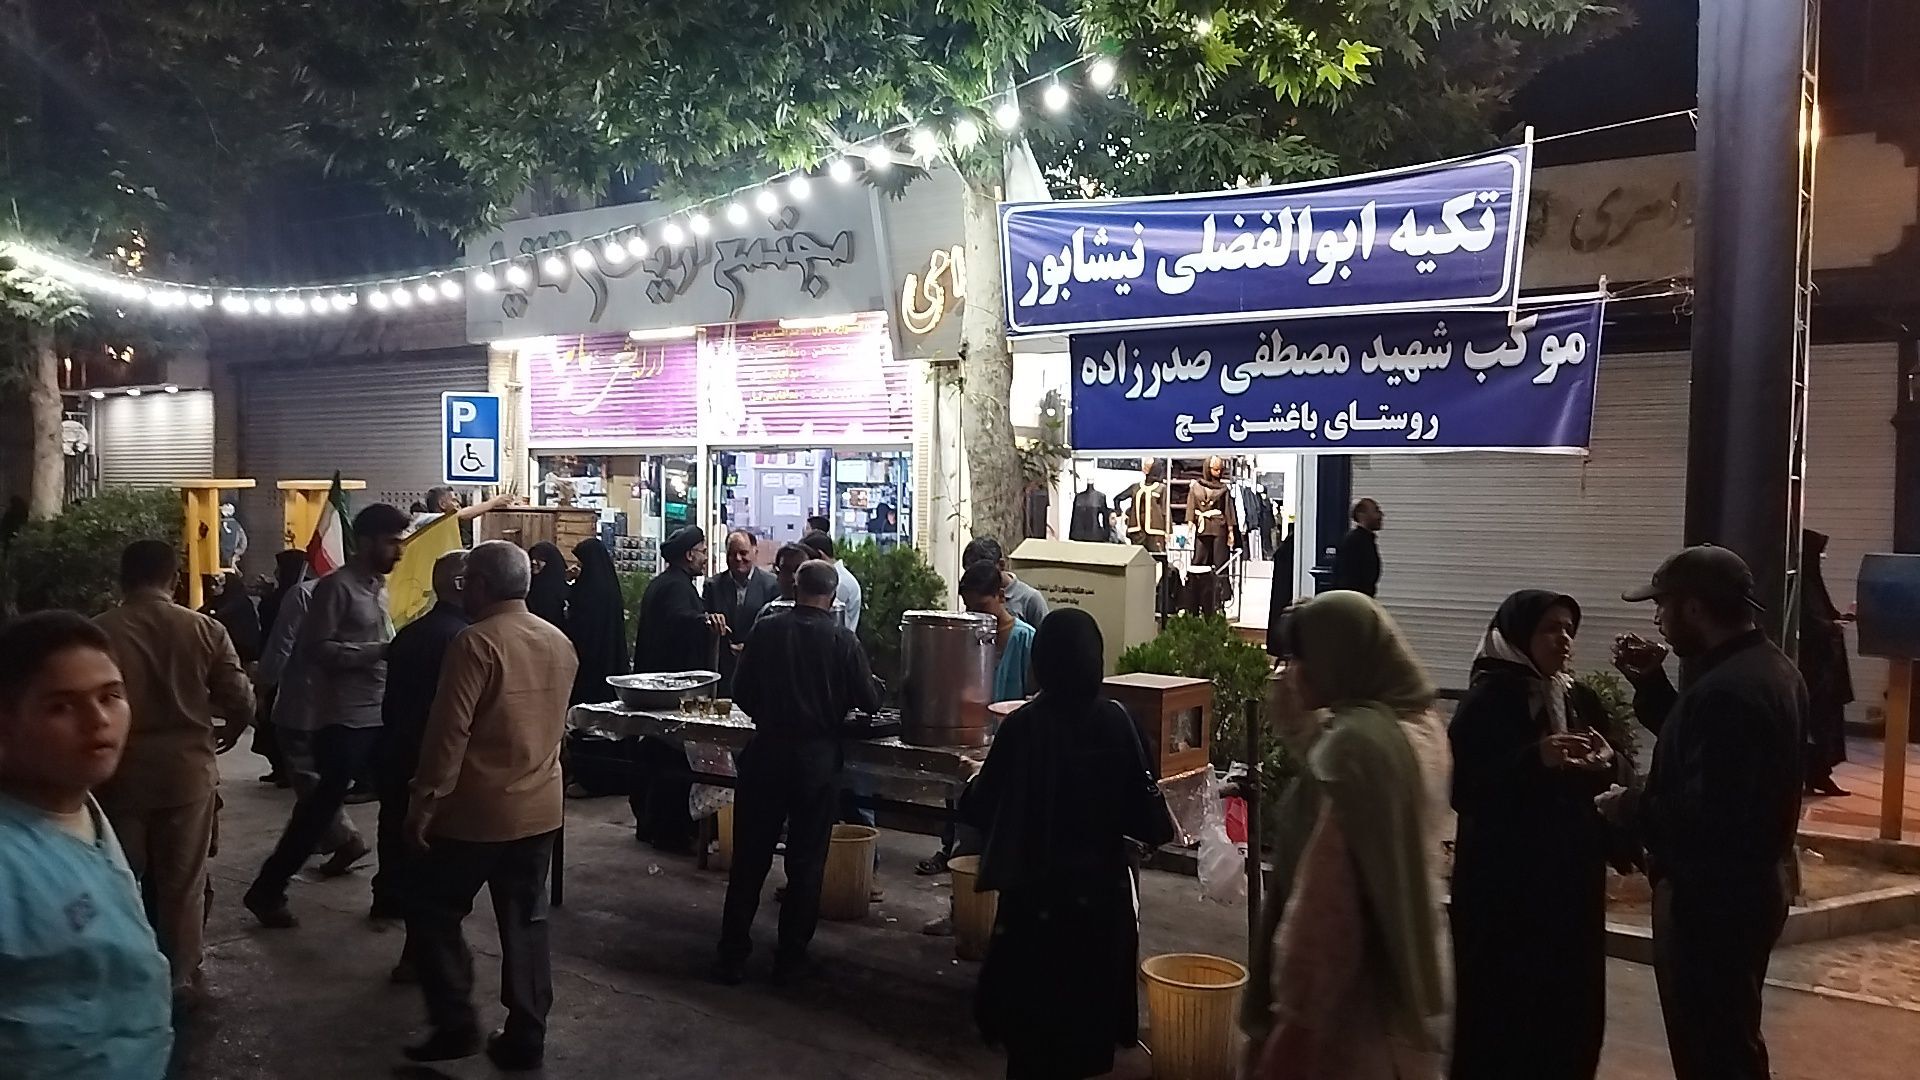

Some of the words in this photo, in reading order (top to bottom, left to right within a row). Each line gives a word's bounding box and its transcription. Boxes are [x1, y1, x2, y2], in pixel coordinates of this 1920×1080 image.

[1019, 221, 1145, 307] نیشابور
[1156, 200, 1376, 295] ابوالفضلی
[1389, 190, 1500, 274] تکیه
[1081, 339, 1211, 399] صدرزاده
[1220, 328, 1350, 394] مصطفی
[1361, 320, 1452, 386] شهید
[1464, 313, 1586, 384] موکب
[452, 401, 477, 433] P
[1175, 404, 1225, 442] گچ
[1229, 401, 1318, 441] باغشن
[1324, 400, 1439, 440] روستای
